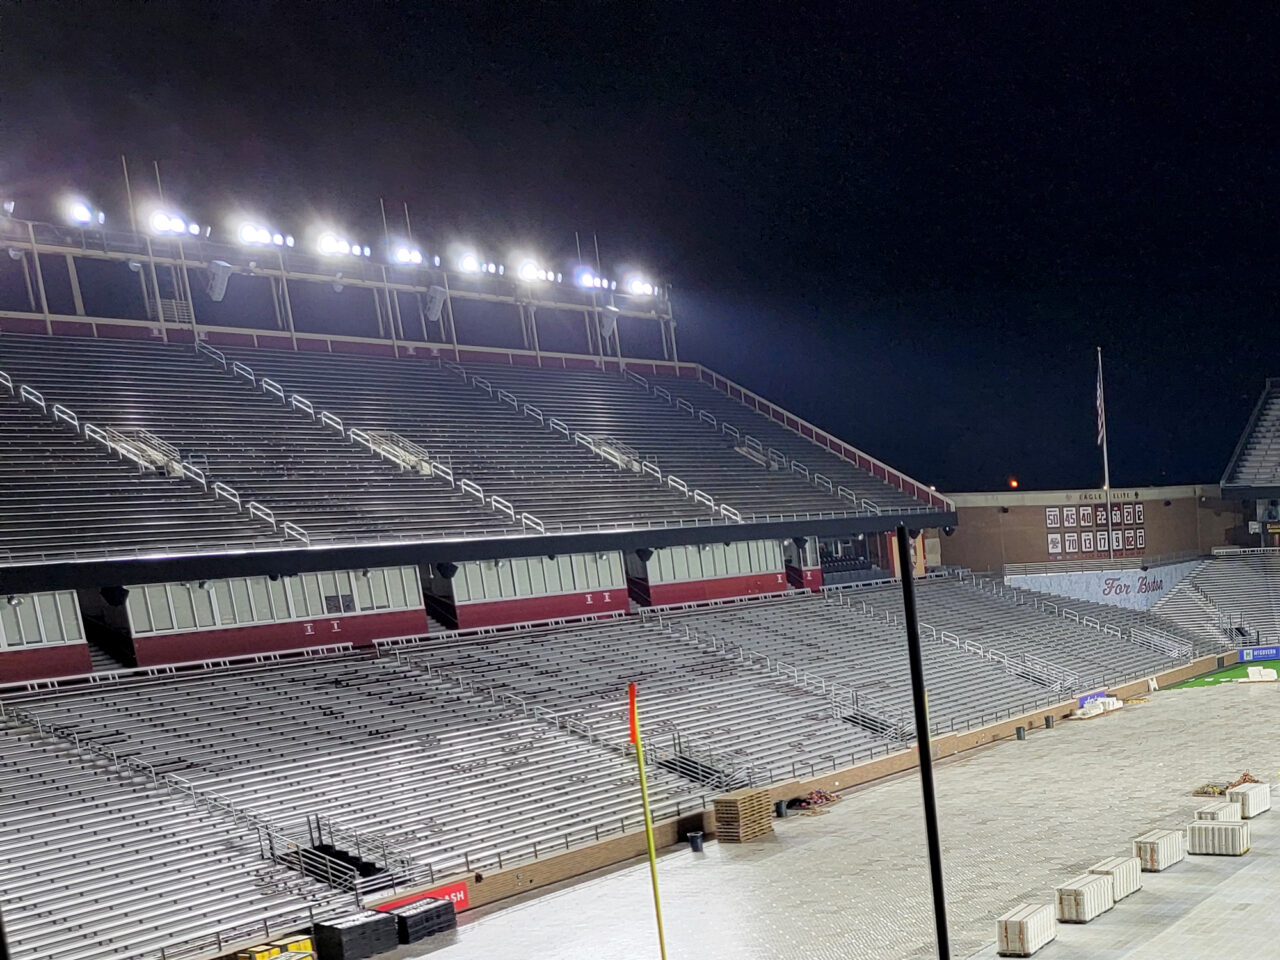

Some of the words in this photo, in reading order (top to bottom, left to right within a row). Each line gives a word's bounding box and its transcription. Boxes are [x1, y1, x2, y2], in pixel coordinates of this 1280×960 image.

[1048, 513, 1059, 526] 50
[1065, 513, 1076, 525] 45
[1081, 512, 1092, 524] 40
[1097, 511, 1107, 524] 22
[1066, 538, 1077, 550] 70
[1084, 537, 1092, 549] 13
[1099, 537, 1107, 549] 17
[1102, 577, 1132, 596] For
